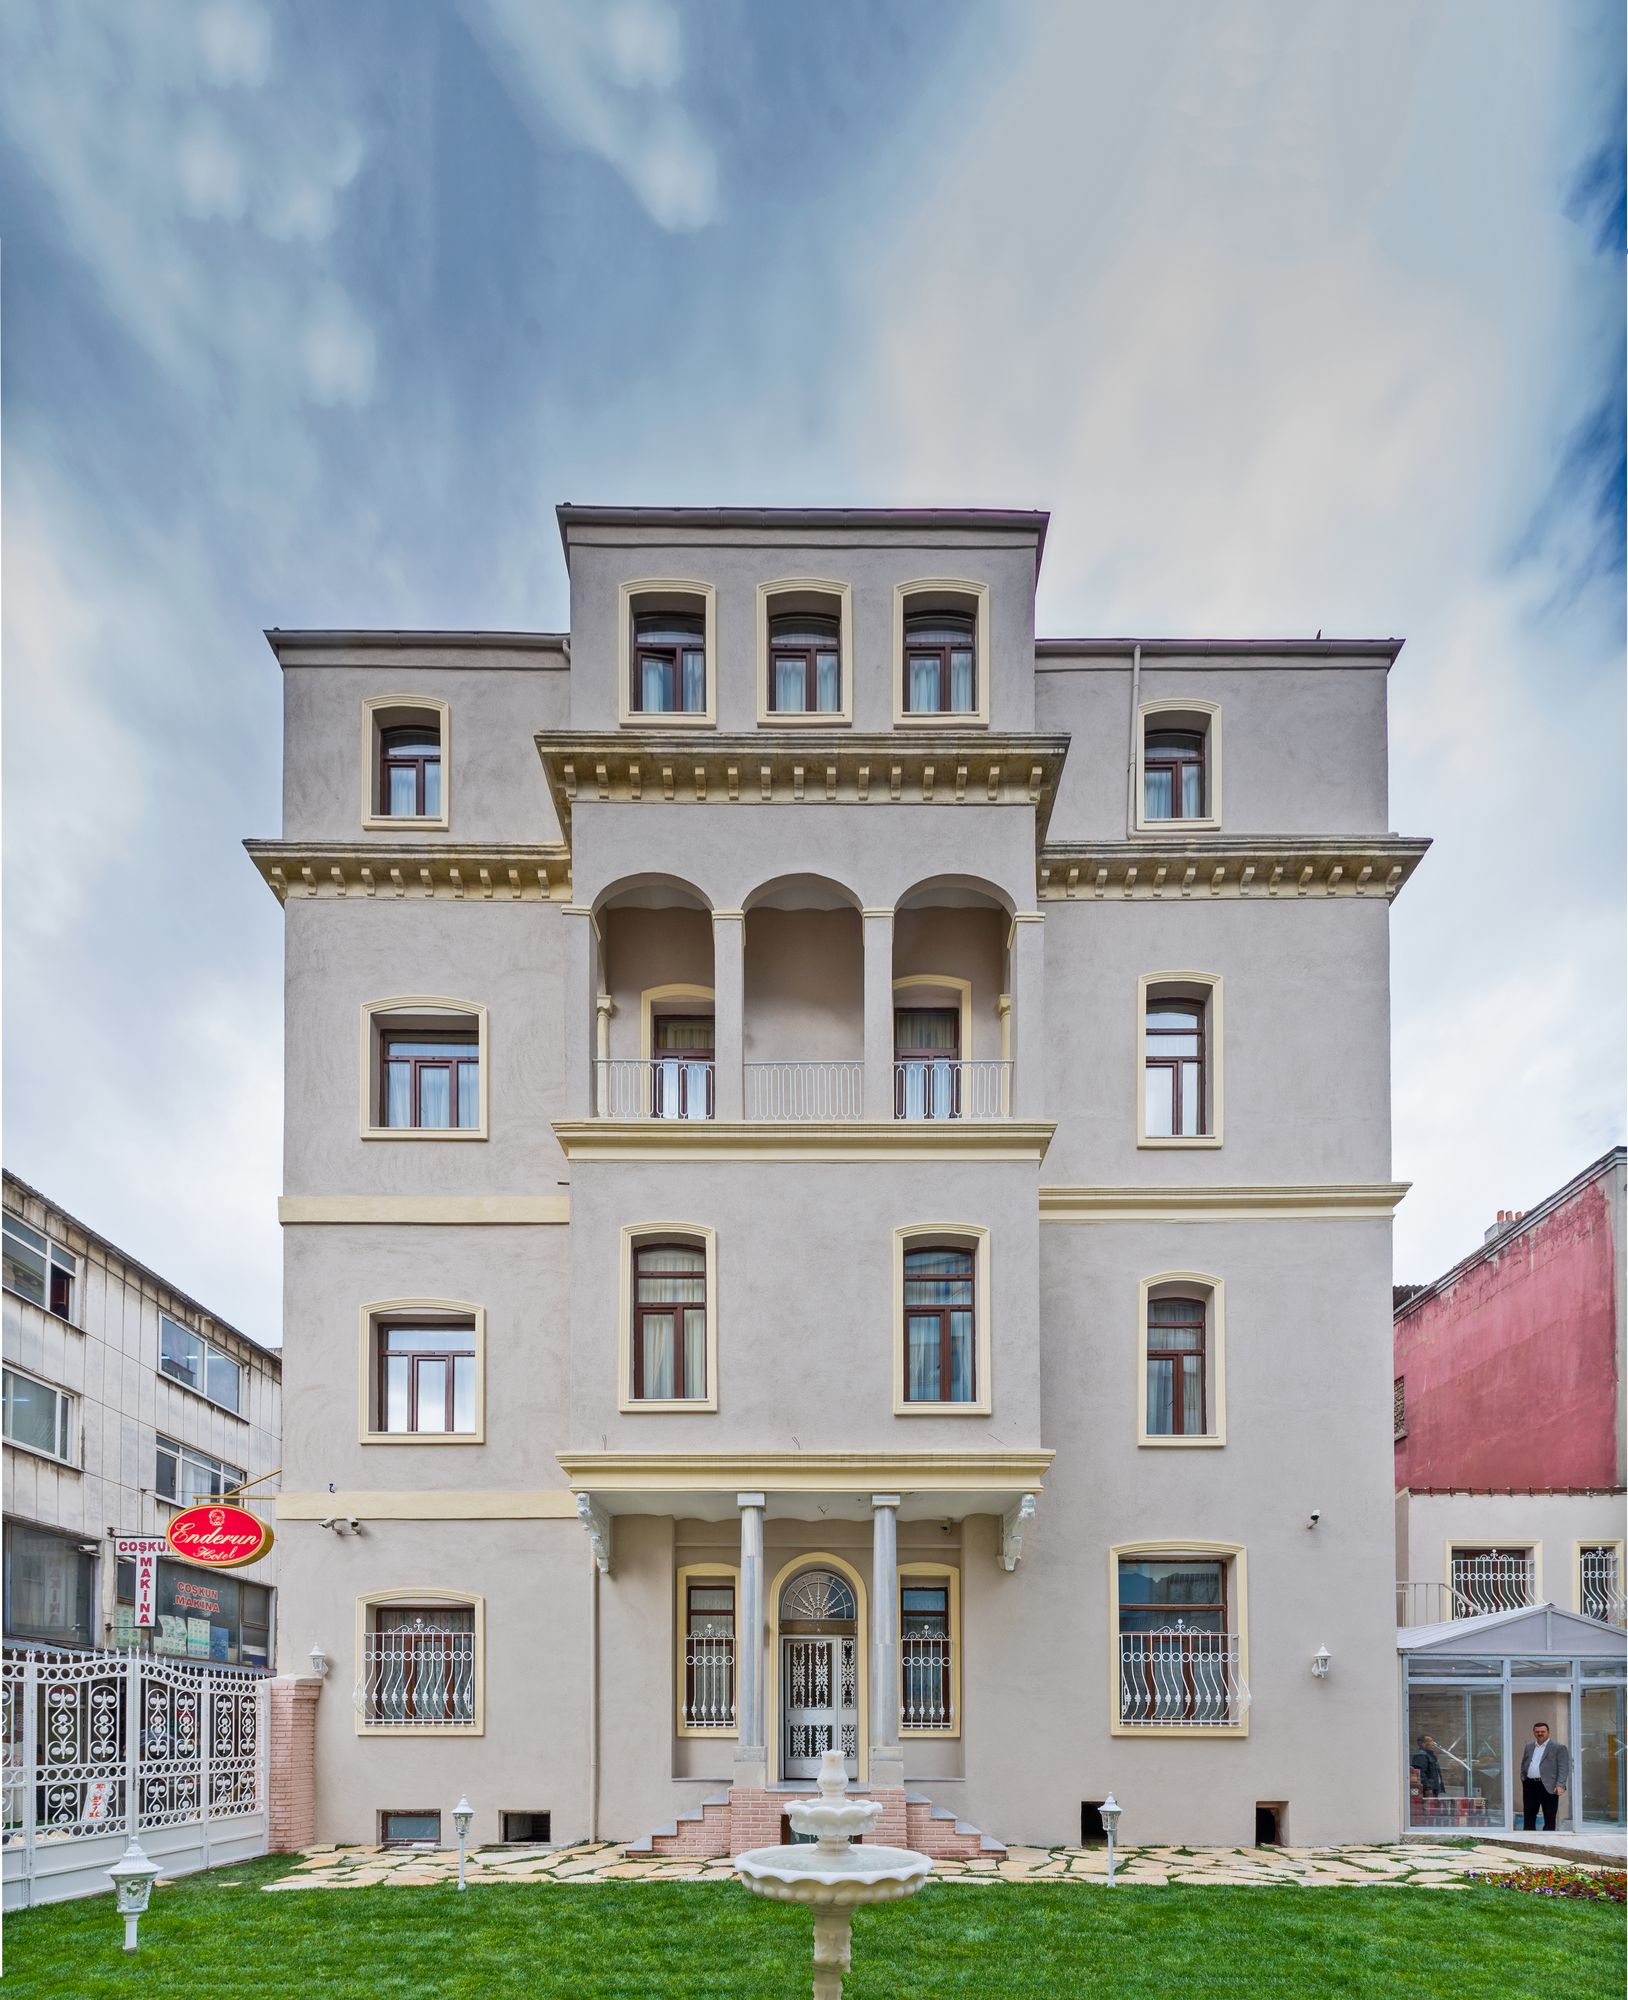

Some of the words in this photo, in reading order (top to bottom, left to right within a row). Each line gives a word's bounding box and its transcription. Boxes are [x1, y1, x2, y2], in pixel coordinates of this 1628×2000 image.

[172, 1522, 260, 1545] Enderun
[193, 1546, 239, 1560] Hotel
[140, 1557, 152, 1624] MAKİNA
